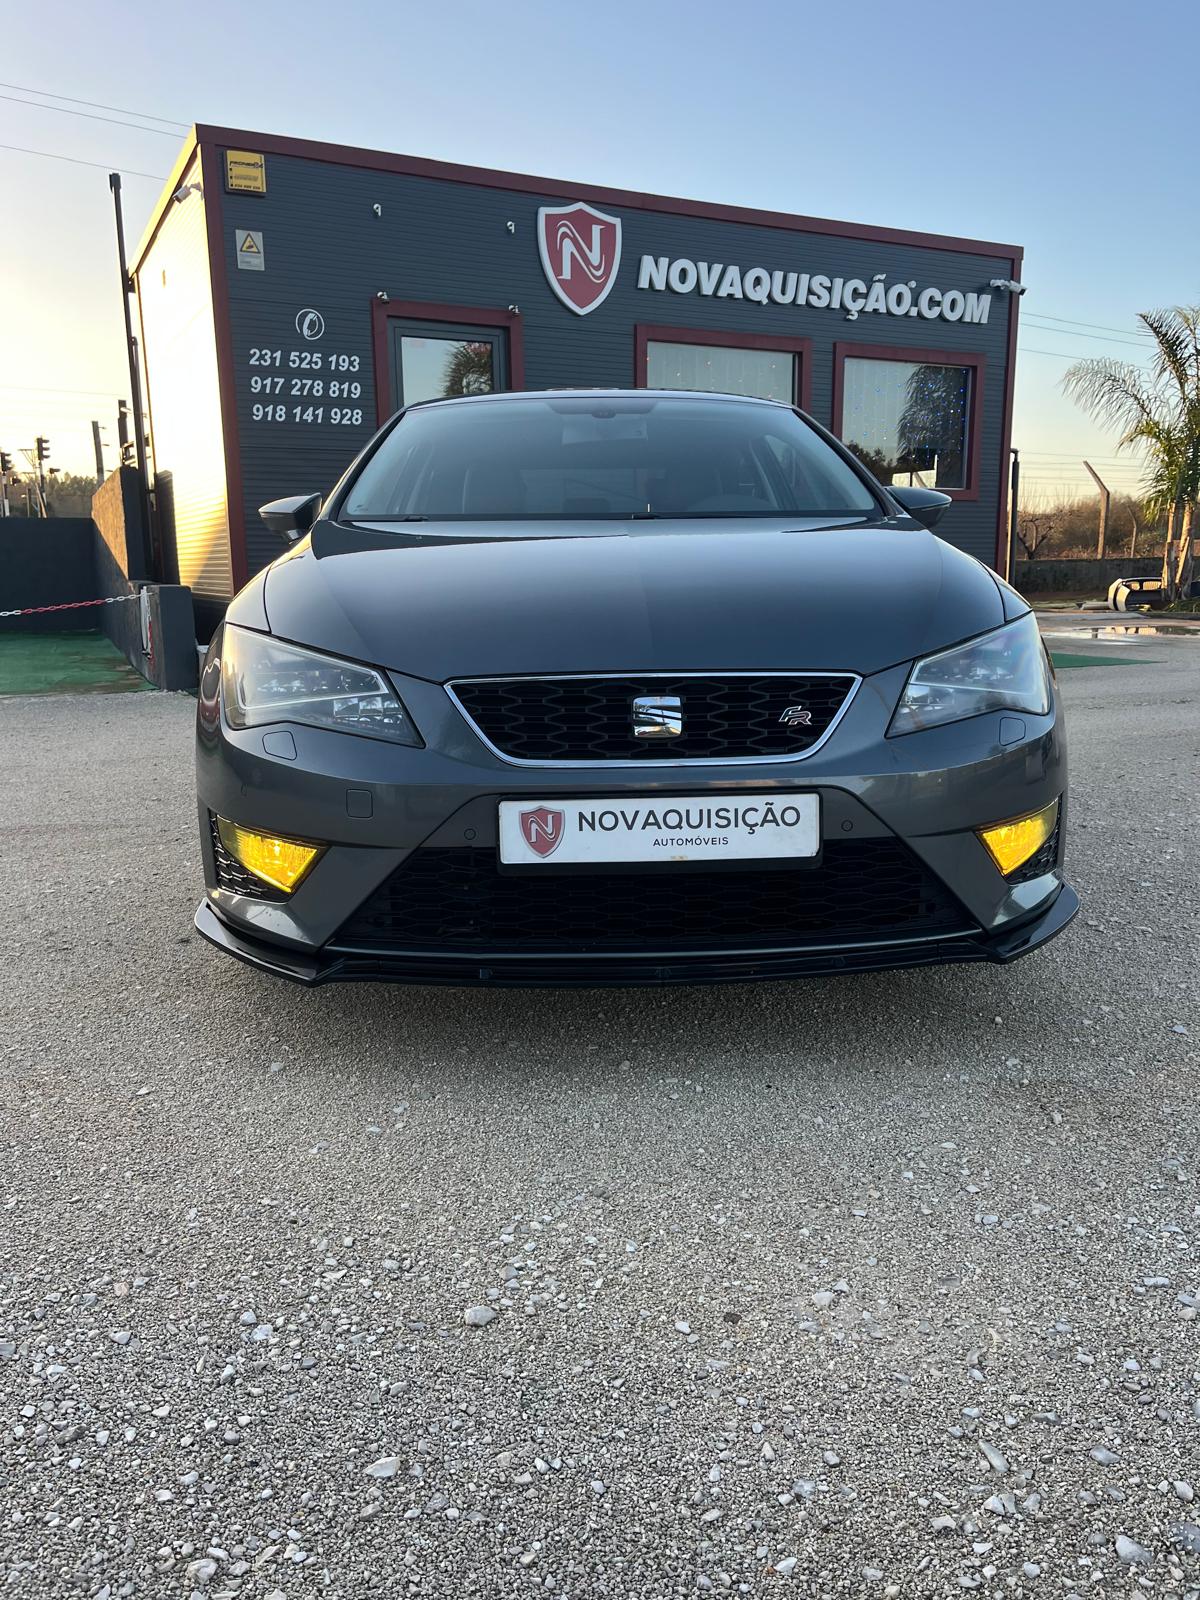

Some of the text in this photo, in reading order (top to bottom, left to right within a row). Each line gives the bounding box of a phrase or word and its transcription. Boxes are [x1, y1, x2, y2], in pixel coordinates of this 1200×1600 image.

[249, 348, 360, 372] 231 525 193
[250, 376, 361, 399] 917 278 819
[252, 404, 362, 426] 918 141 928
[577, 800, 802, 836] NOVAQUISIÇÃO
[652, 835, 730, 848] AUTOMÓVEIS
